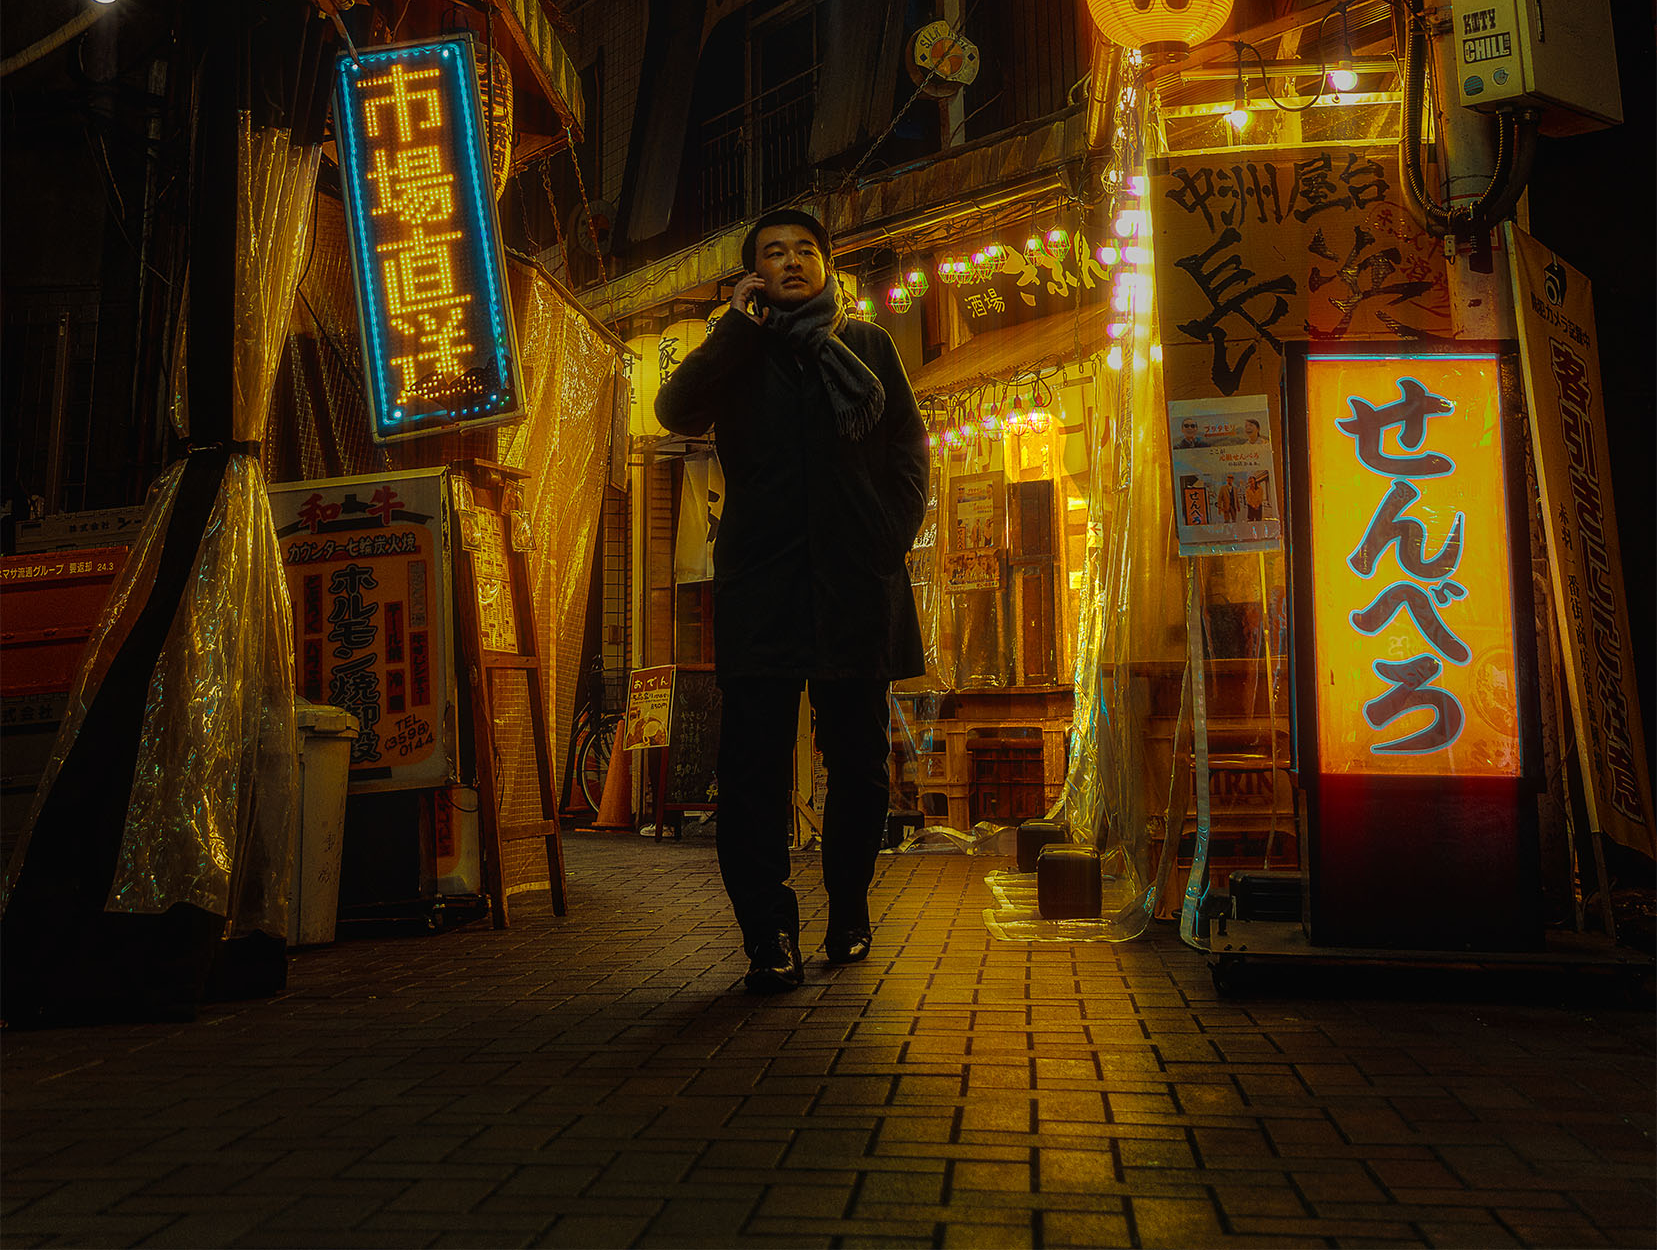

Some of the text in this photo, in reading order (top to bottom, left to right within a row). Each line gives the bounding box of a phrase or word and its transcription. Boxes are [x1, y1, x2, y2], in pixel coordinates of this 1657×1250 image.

[1464, 35, 1510, 62] CHILL
[357, 63, 482, 405] 市場直送
[965, 287, 1007, 319] 酒場
[298, 486, 405, 533] 和牛
[1335, 376, 1473, 755] せんべろ
[633, 676, 669, 690] おでん
[394, 714, 422, 732] TEL
